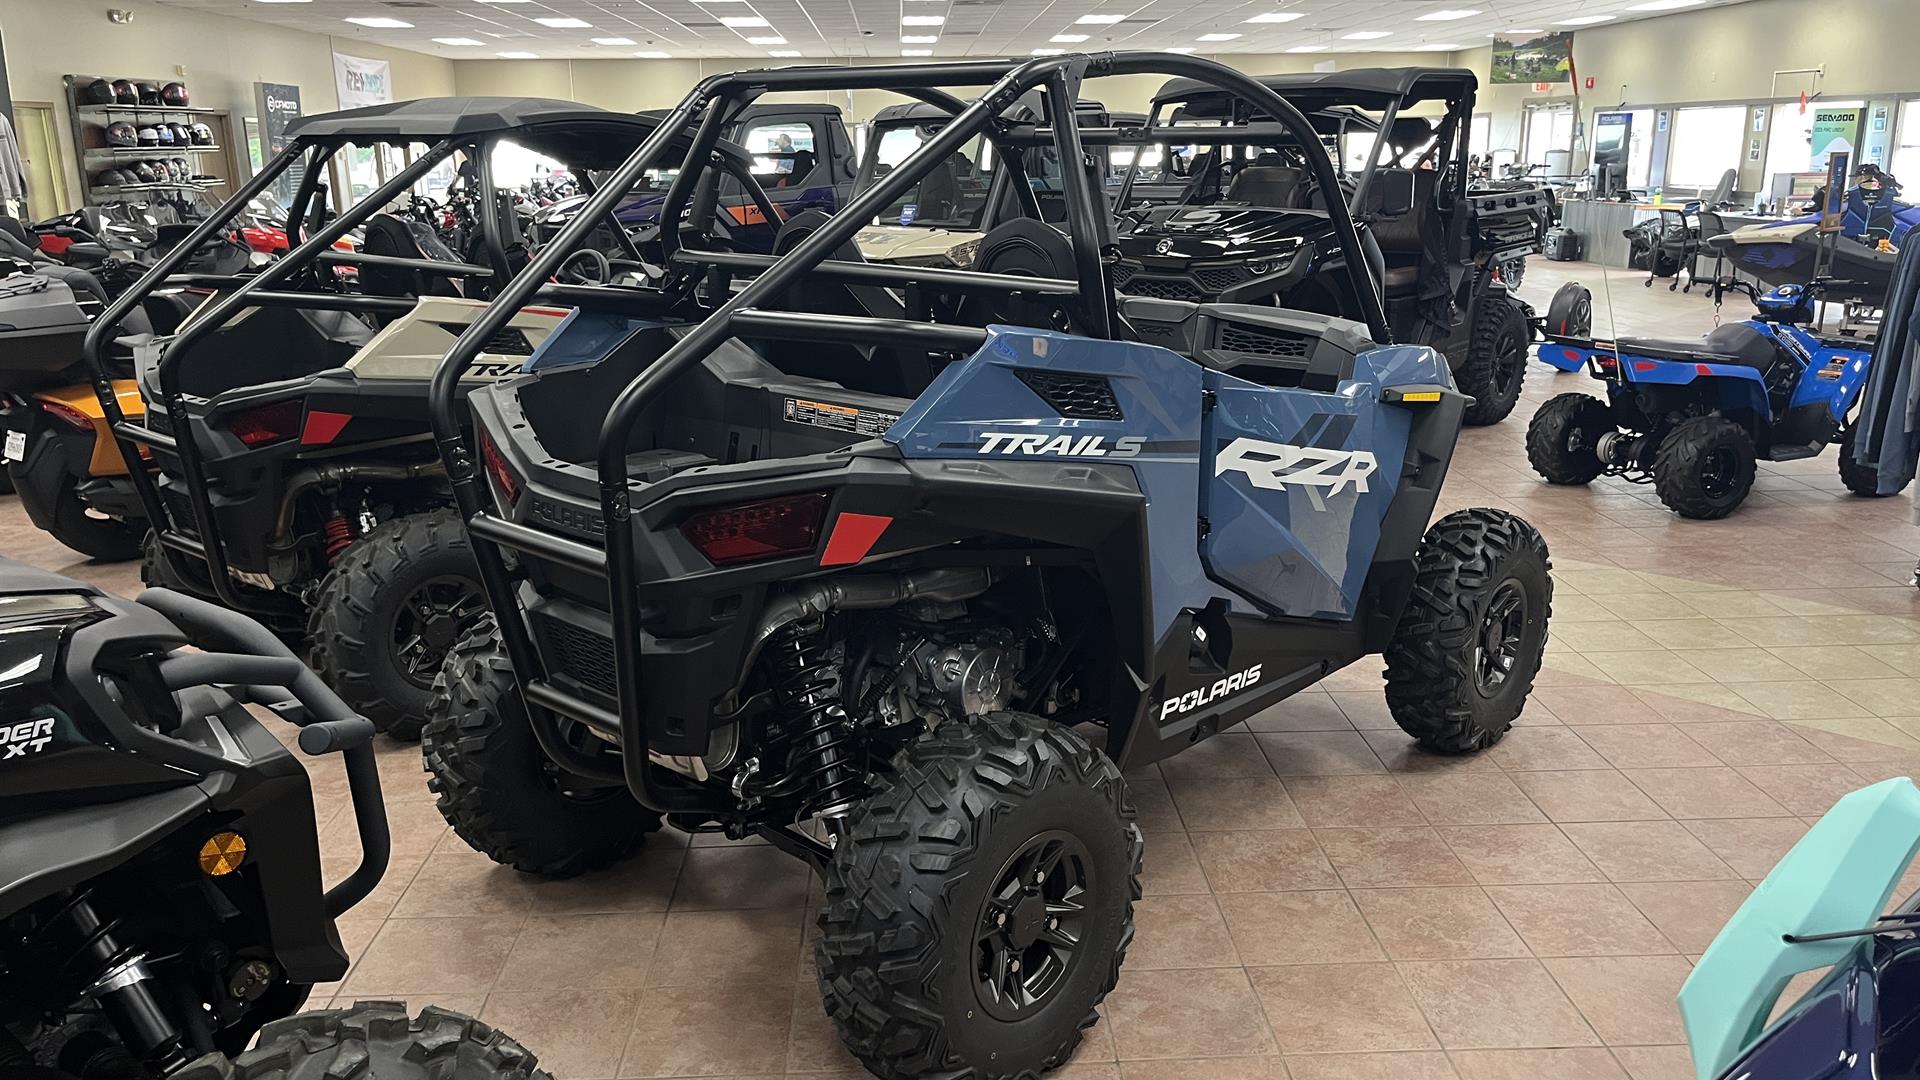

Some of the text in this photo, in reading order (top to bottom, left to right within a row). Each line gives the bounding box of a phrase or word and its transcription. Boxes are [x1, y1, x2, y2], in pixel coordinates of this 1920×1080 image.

[1215, 437, 1378, 498] RZR
[1160, 663, 1262, 720] POLARIS
[2, 736, 53, 759] XT
